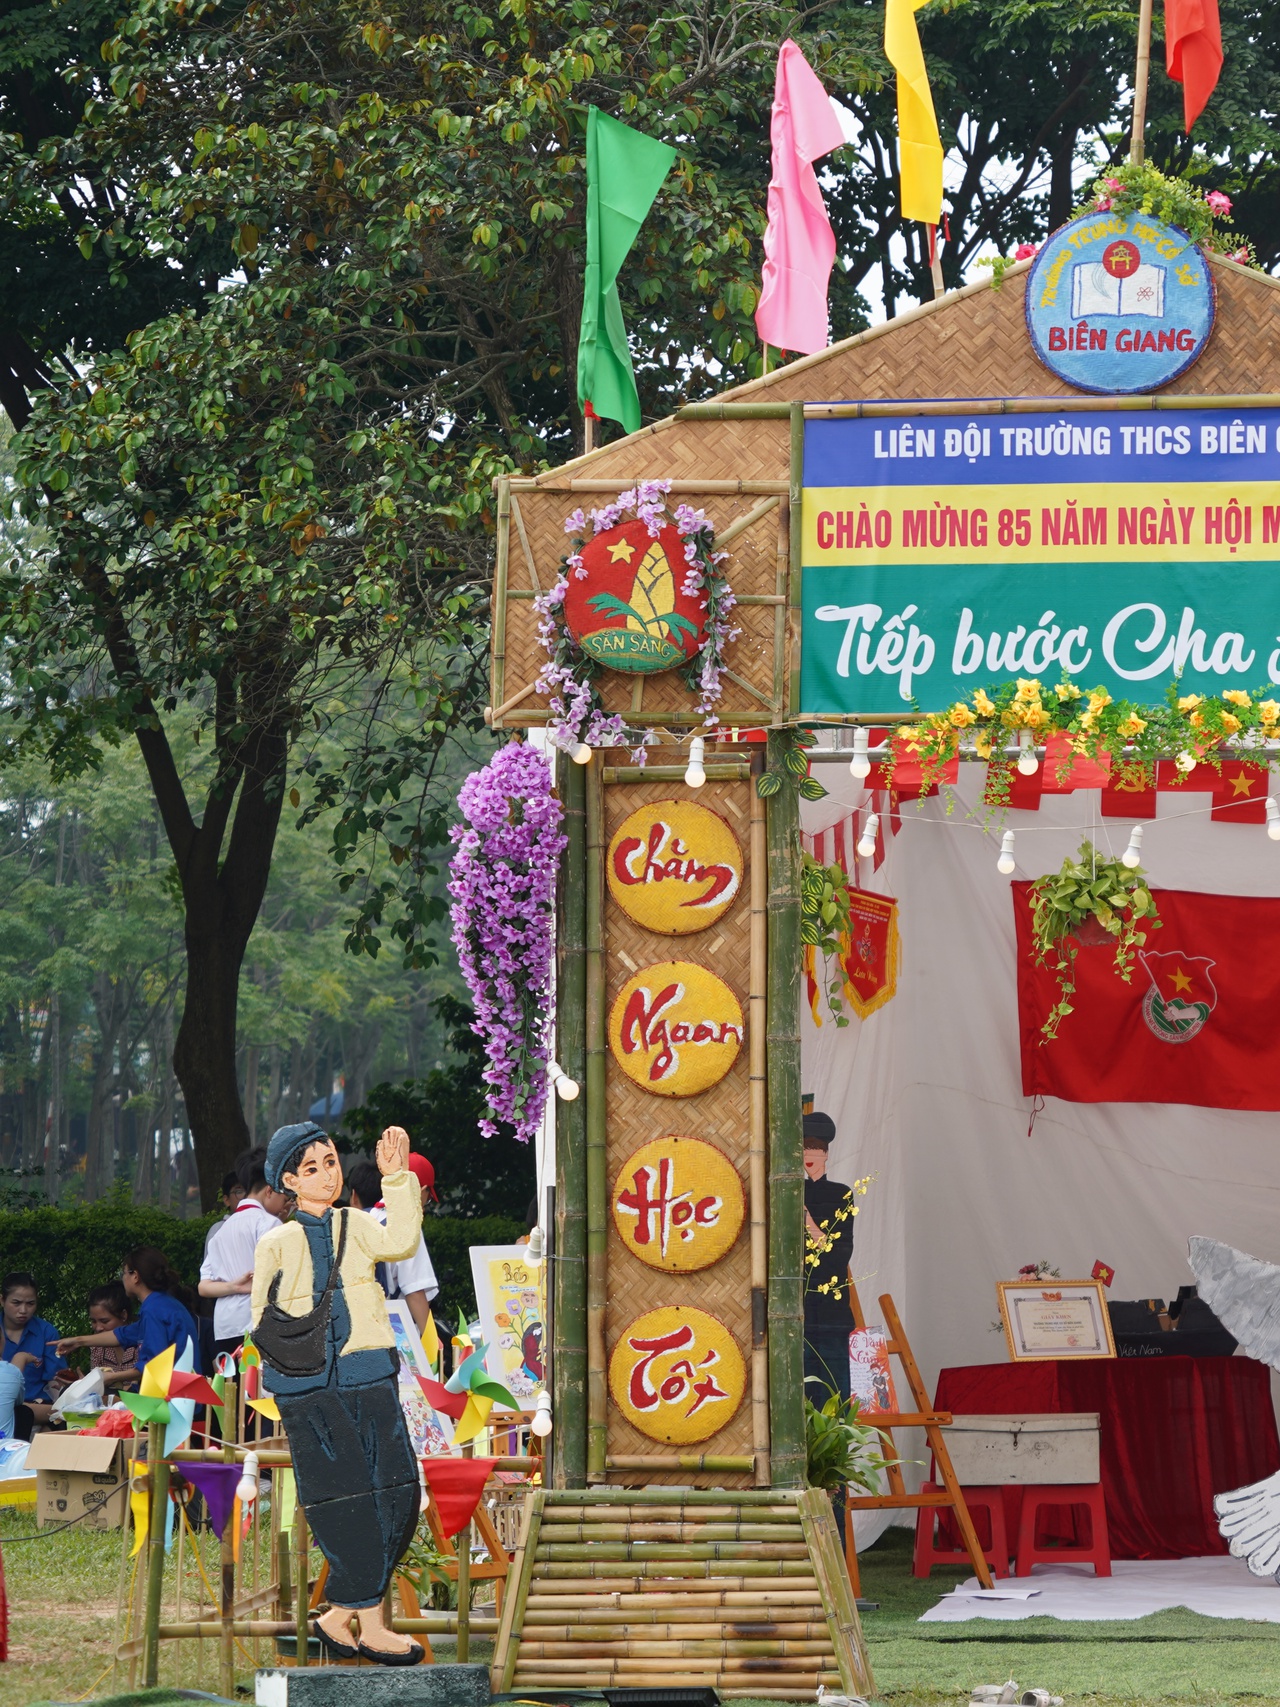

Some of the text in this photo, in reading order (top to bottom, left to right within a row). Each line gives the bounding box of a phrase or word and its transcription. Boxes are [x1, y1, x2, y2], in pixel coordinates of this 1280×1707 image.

[1068, 219, 1129, 249] TRUNG
[1048, 320, 1197, 352] BIÊN GIANG
[874, 423, 936, 459] LIÊN
[943, 422, 991, 464] ĐỘI
[999, 419, 1111, 457] TRƯỜNG
[1119, 425, 1192, 455] THCS
[1200, 418, 1267, 454] BIÊN
[816, 502, 890, 550] CHÀO
[902, 501, 988, 549] MỪNG
[998, 508, 1032, 547] 85
[1041, 499, 1108, 546] NĂM
[1117, 498, 1196, 545] NGÀY
[1204, 499, 1252, 554] HỘI
[630, 633, 671, 658] SÀNG
[814, 602, 936, 702] Tiếp
[951, 607, 1092, 676] bước
[1102, 602, 1256, 682] Cha
[616, 1158, 723, 1261] Học
[626, 1324, 730, 1418] Tốt
